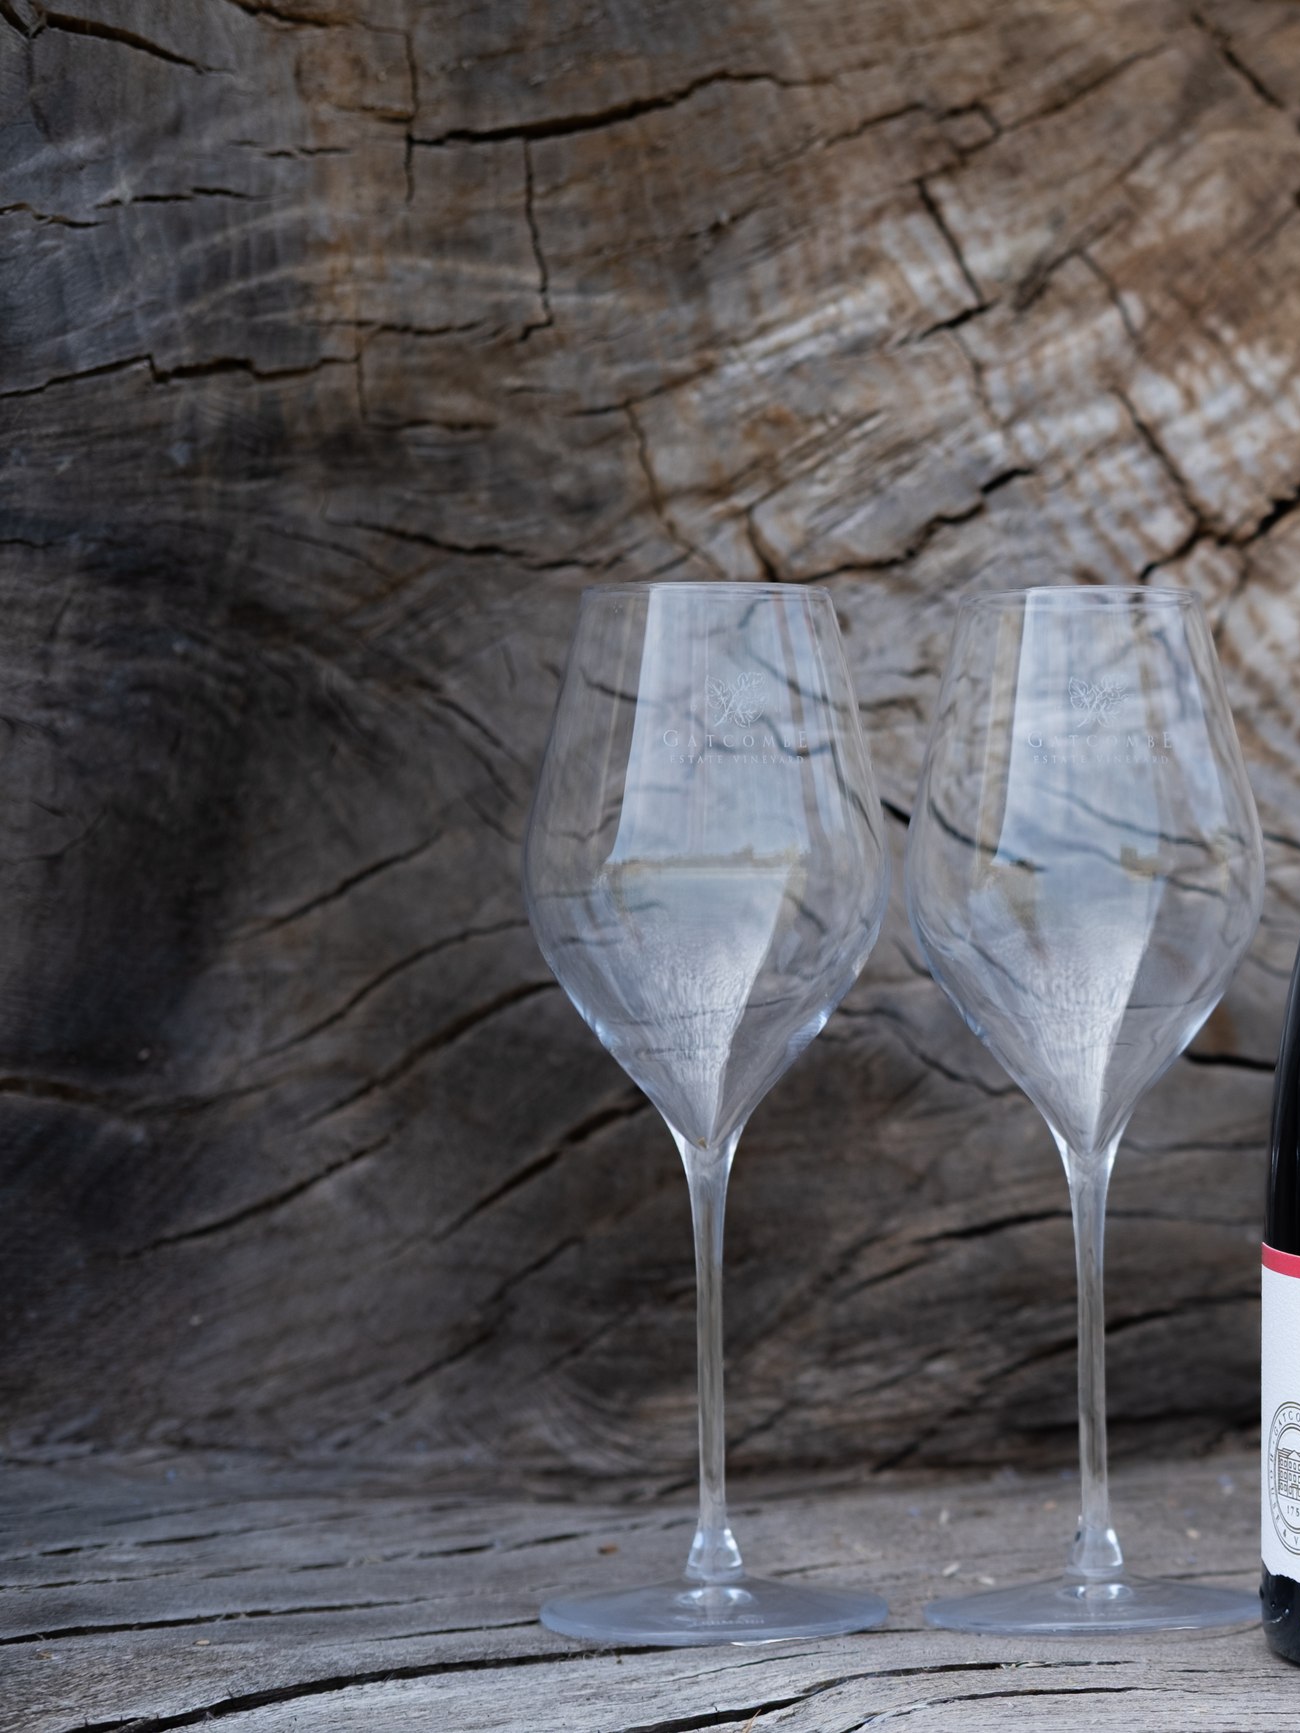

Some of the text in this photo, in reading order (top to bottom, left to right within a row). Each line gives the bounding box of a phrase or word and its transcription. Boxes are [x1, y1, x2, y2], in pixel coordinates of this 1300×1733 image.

[662, 729, 808, 748] GATCOMBE
[1027, 731, 1173, 749] GATCOMBE
[670, 754, 805, 764] ESTATE VINEYARD
[1033, 755, 1087, 764] ESTATE
